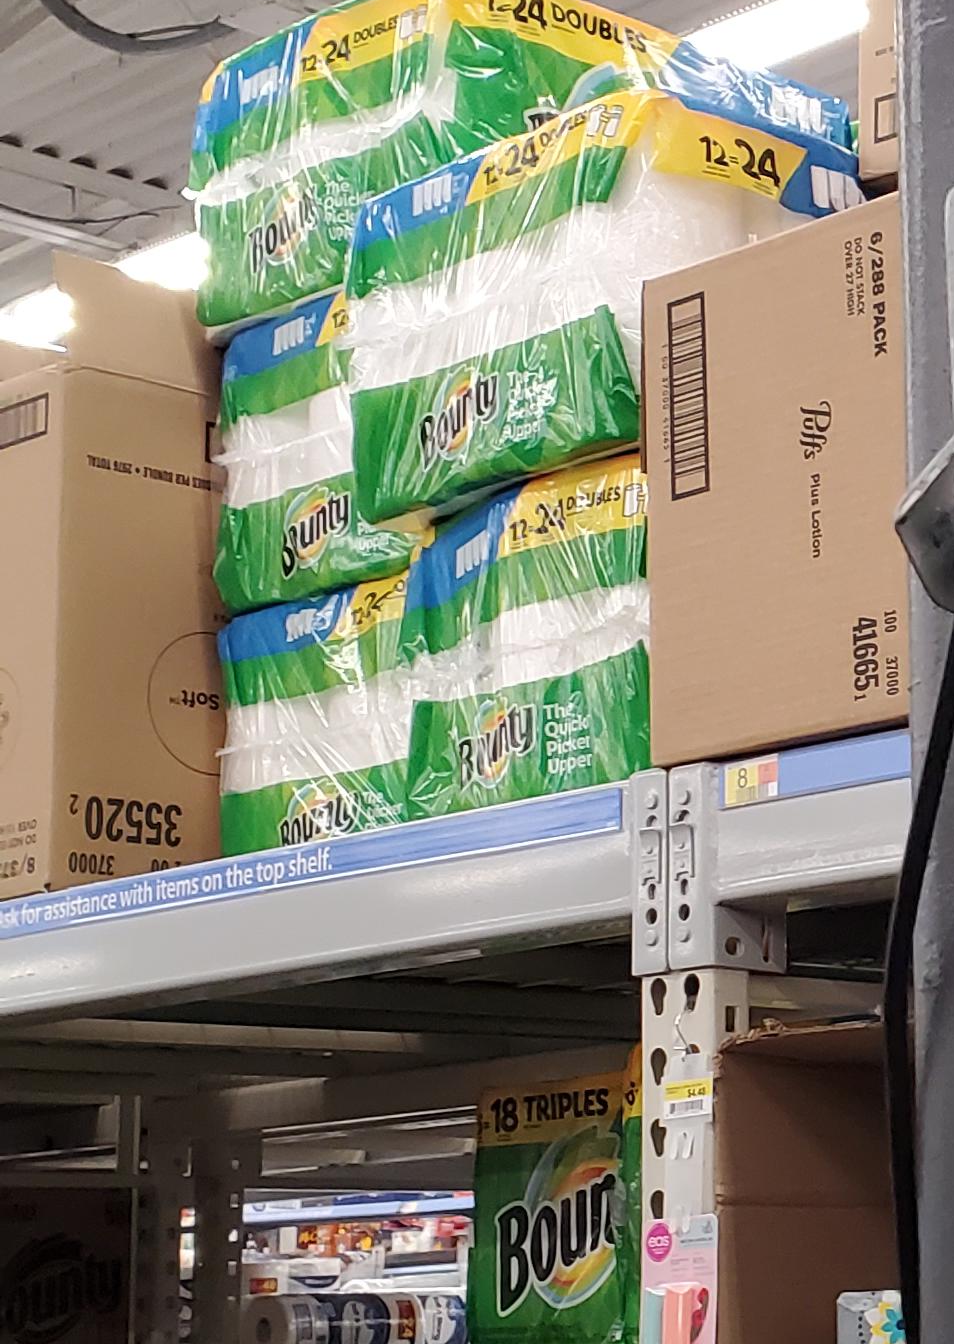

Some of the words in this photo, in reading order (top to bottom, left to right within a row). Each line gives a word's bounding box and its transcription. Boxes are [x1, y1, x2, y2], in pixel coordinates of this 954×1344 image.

[352, 13, 399, 45] DOUBLES
[843, 240, 854, 269] OVER
[854, 236, 863, 254] DO
[855, 256, 864, 279] NOT
[868, 231, 885, 296] 6/288
[846, 287, 856, 317] HIGH
[855, 282, 865, 317] STACK
[872, 301, 888, 358] PACK
[799, 400, 833, 461] Puffs
[810, 472, 821, 506] Plus
[811, 510, 824, 559] Lotion
[884, 609, 897, 633] 100
[852, 616, 880, 691] 41665
[885, 655, 900, 697] 37000
[543, 702, 575, 720] The
[545, 735, 592, 756] Picker
[547, 753, 594, 779] Upper
[737, 767, 748, 788] 8
[85, 795, 183, 848] 35520
[68, 850, 116, 876] 37000
[21, 900, 45, 926] for
[45, 891, 117, 921] assistance
[119, 881, 153, 909] with
[155, 875, 200, 900] items
[202, 870, 223, 892] on
[225, 862, 253, 887] the
[255, 858, 284, 885] top
[288, 846, 333, 878] shelf.
[523, 1087, 609, 1123] TRIPLES
